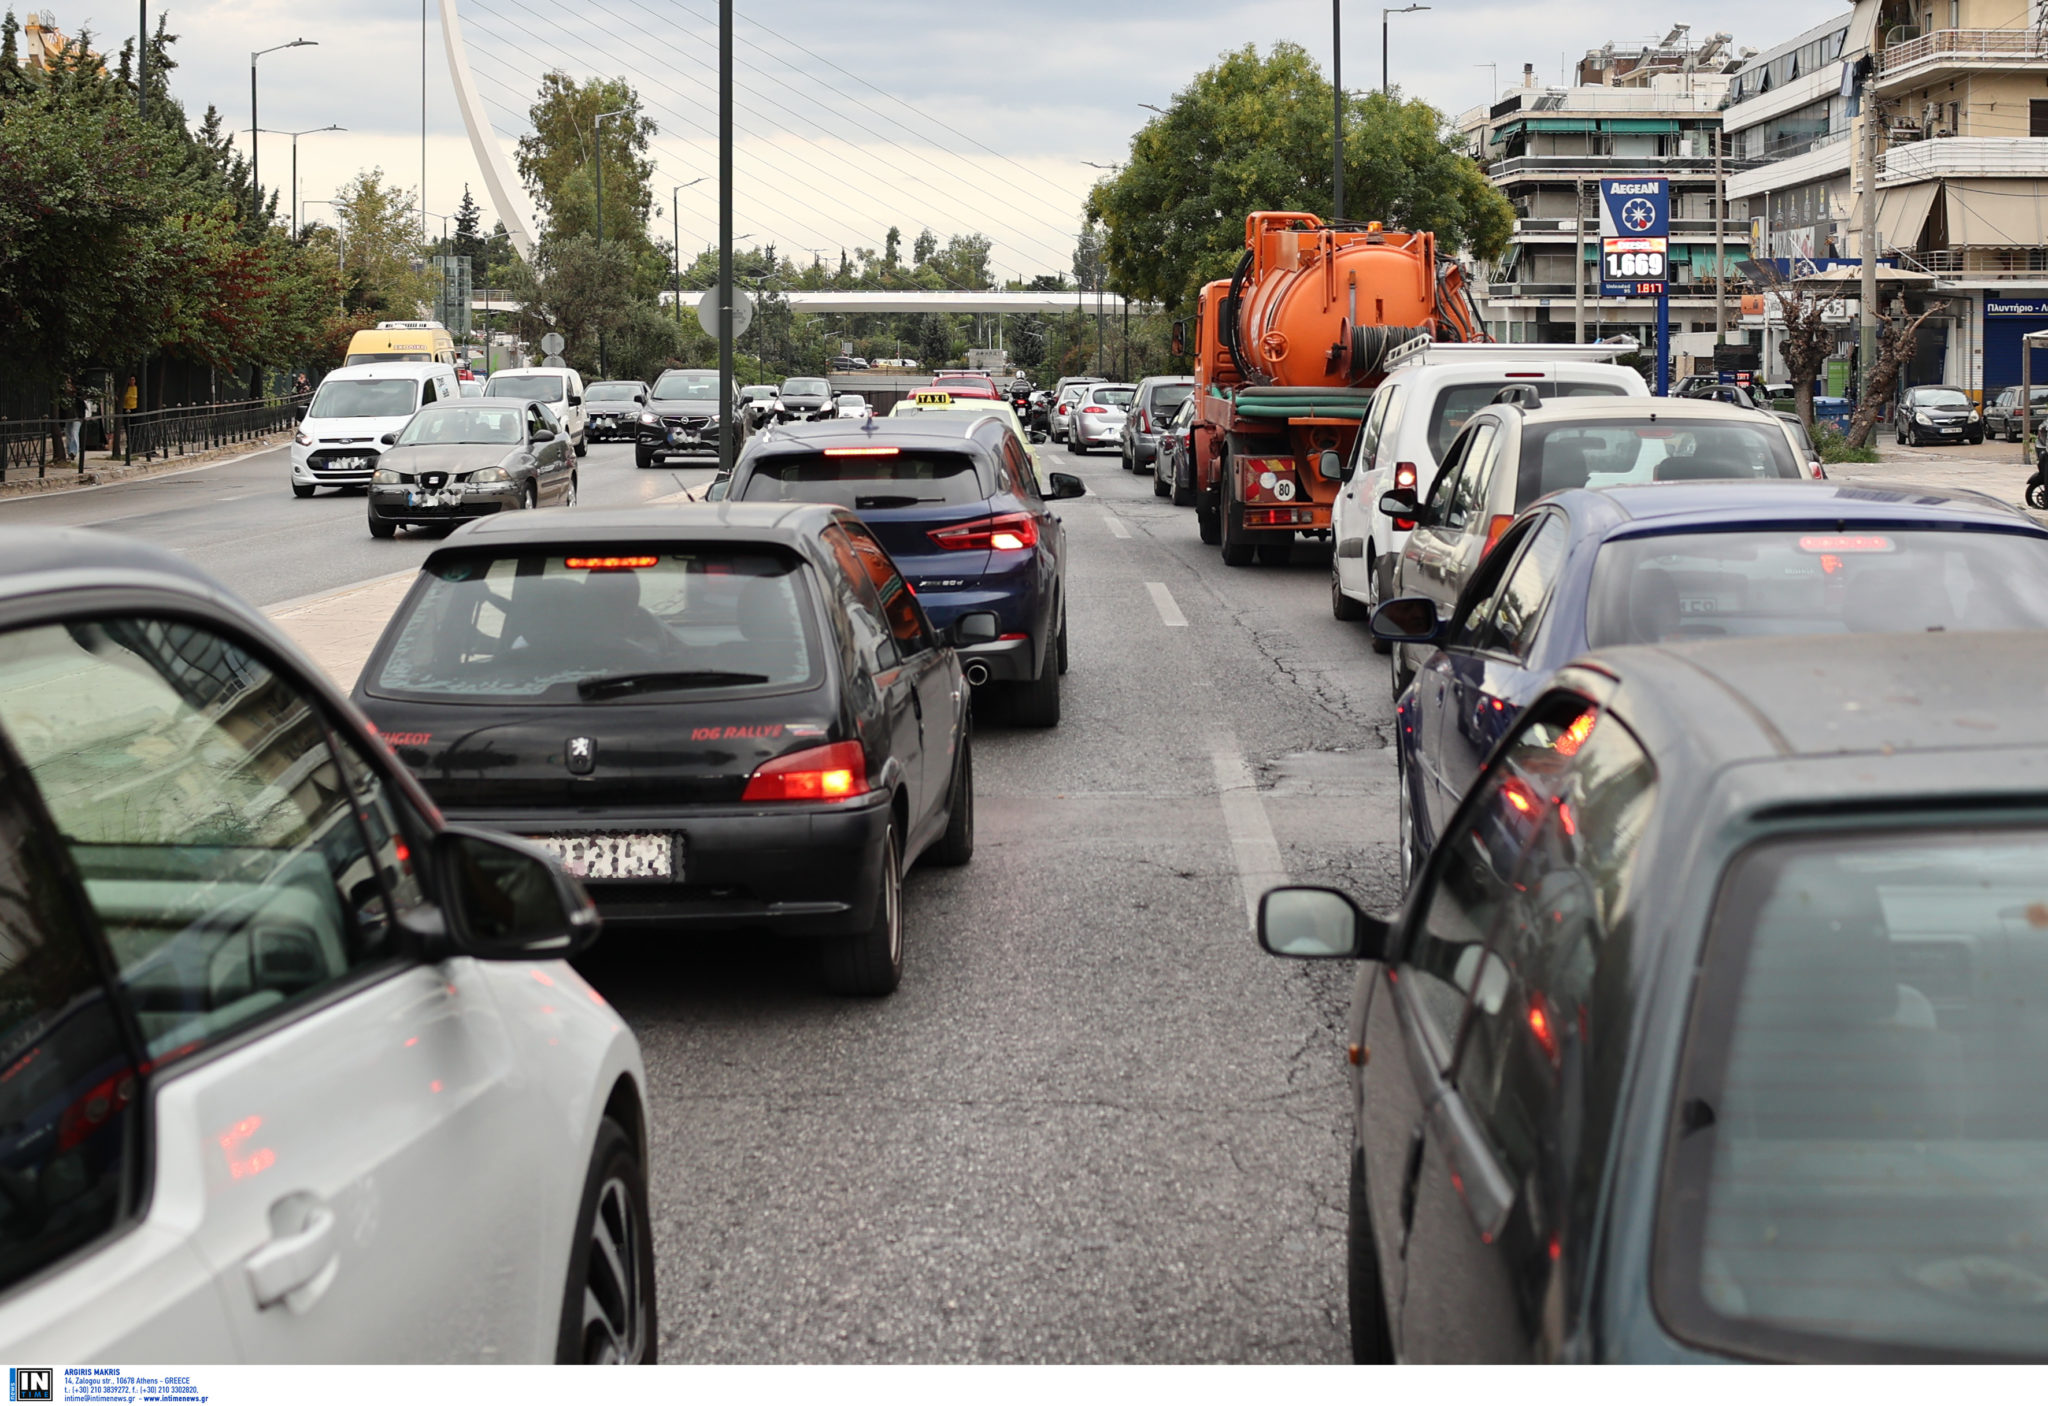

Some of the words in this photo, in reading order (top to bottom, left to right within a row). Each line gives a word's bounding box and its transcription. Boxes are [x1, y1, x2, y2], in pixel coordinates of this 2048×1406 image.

[1610, 182, 1659, 194] AEGEAN
[1606, 253, 1663, 278] 1,669
[1987, 302, 2033, 314] Πλυντήριο
[919, 395, 946, 403] TAXI
[1278, 483, 1290, 496] 80
[724, 724, 783, 739] RALLYE
